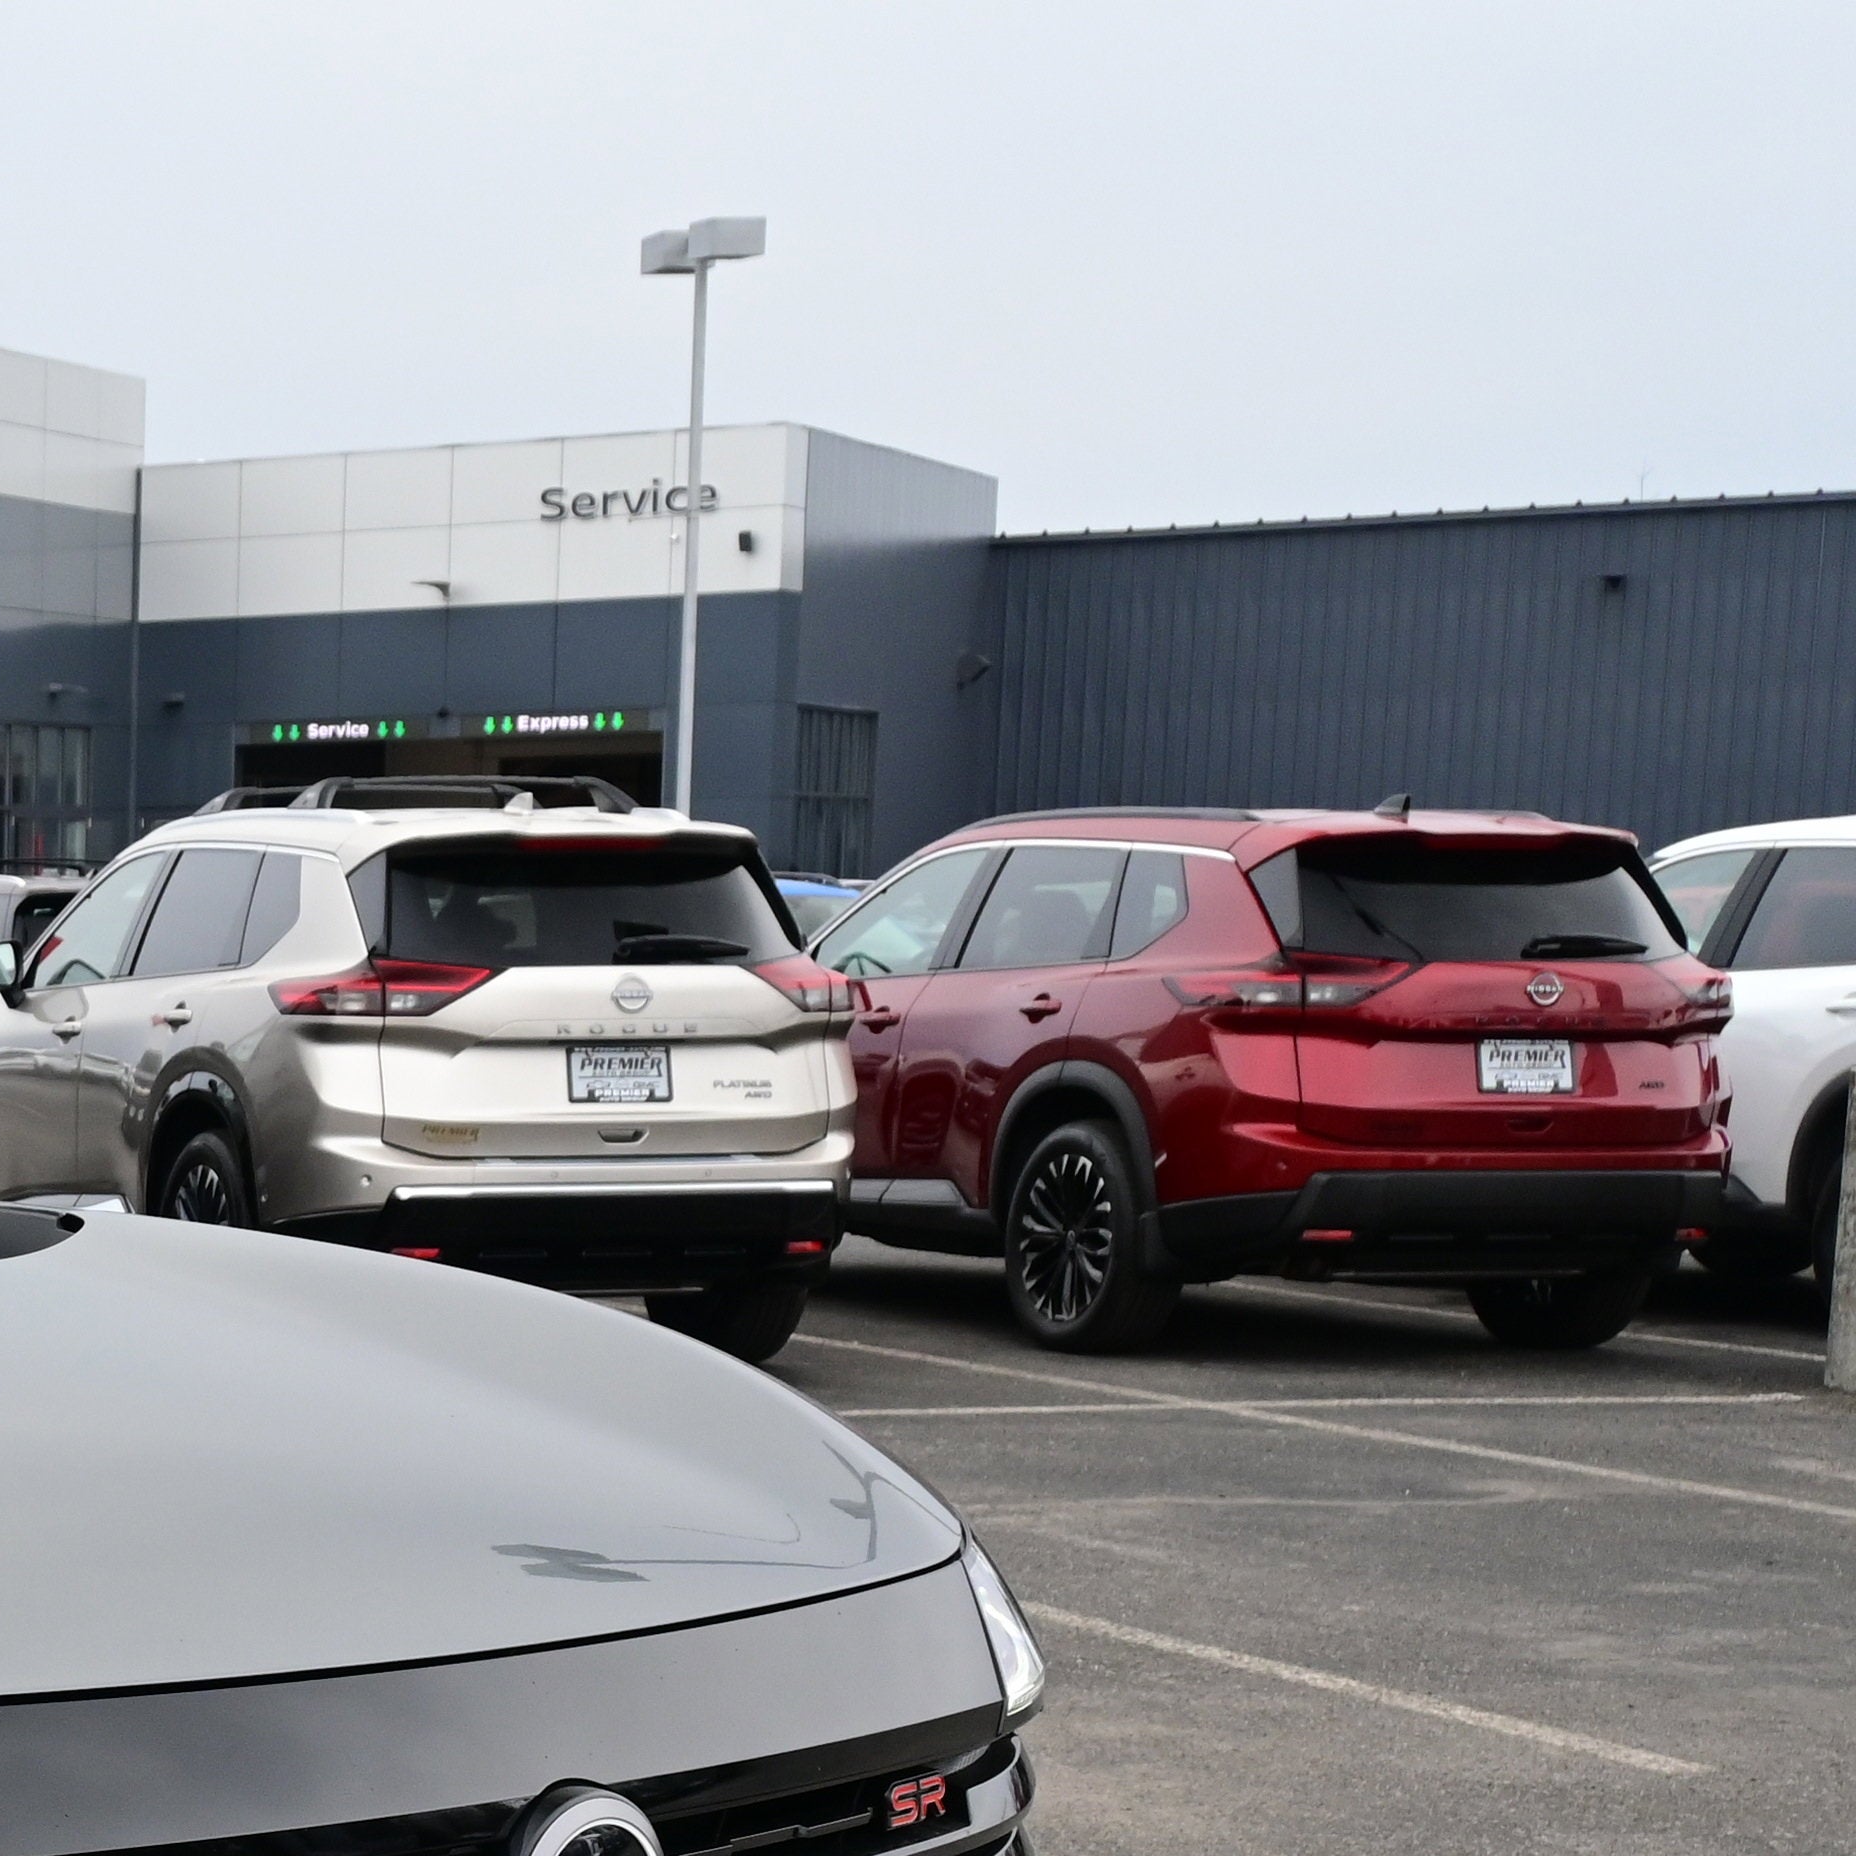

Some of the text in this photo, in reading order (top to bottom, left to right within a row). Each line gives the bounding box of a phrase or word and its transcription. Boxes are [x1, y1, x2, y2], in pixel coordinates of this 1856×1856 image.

[540, 478, 718, 521] Service
[307, 721, 370, 740] Service
[516, 713, 589, 733] Express
[1526, 985, 1564, 994] NISSAN
[557, 1022, 698, 1034] ROGUE
[580, 1056, 663, 1077] PREMIER
[1489, 1049, 1566, 1069] PREMIER
[594, 1088, 649, 1097] PREMIER
[713, 1079, 772, 1089] PLATINUM
[744, 1091, 772, 1099] AWD
[886, 1773, 947, 1828] SR
